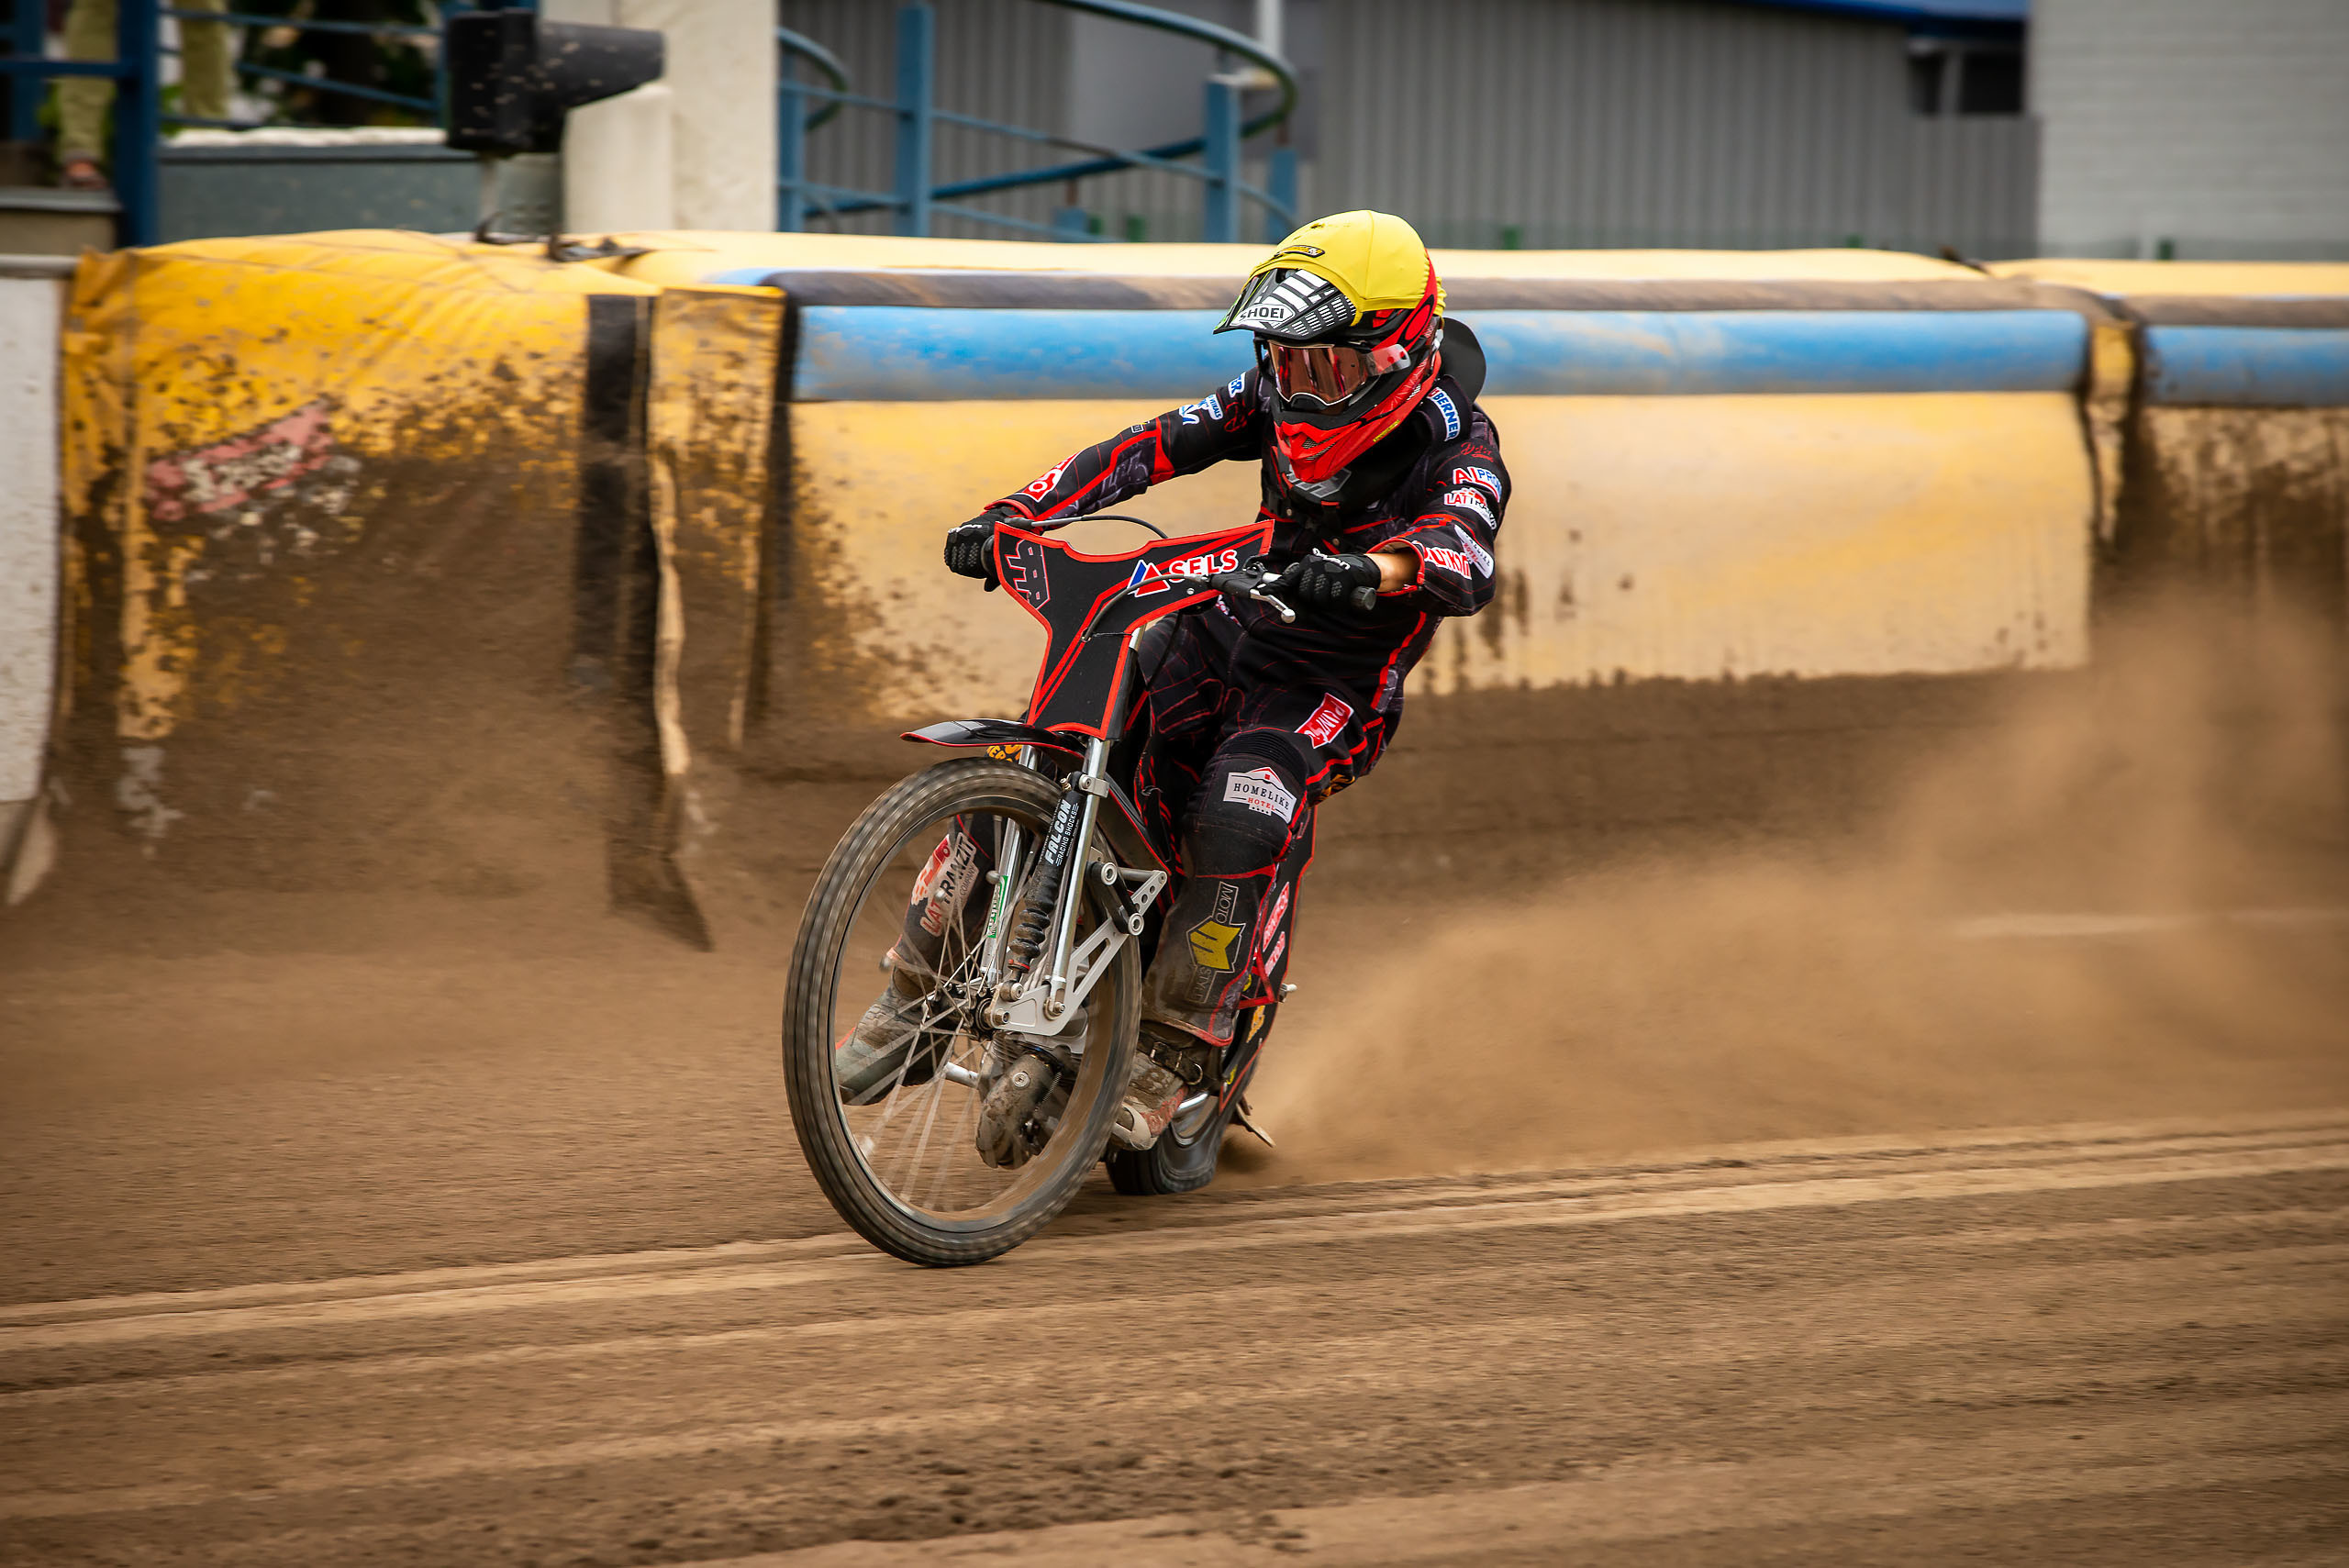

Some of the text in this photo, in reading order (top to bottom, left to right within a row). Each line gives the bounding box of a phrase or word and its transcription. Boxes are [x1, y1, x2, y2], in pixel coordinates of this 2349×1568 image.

[1239, 306, 1285, 322] SHOEI
[1432, 392, 1459, 439] BERNER
[1233, 783, 1290, 810] HOMELIKE
[1248, 796, 1276, 811] HOTEL
[1045, 798, 1072, 865] FALCON
[1058, 837, 1069, 860] RACING
[1064, 811, 1077, 836] SHOCKS
[1216, 885, 1234, 924] MOTO
